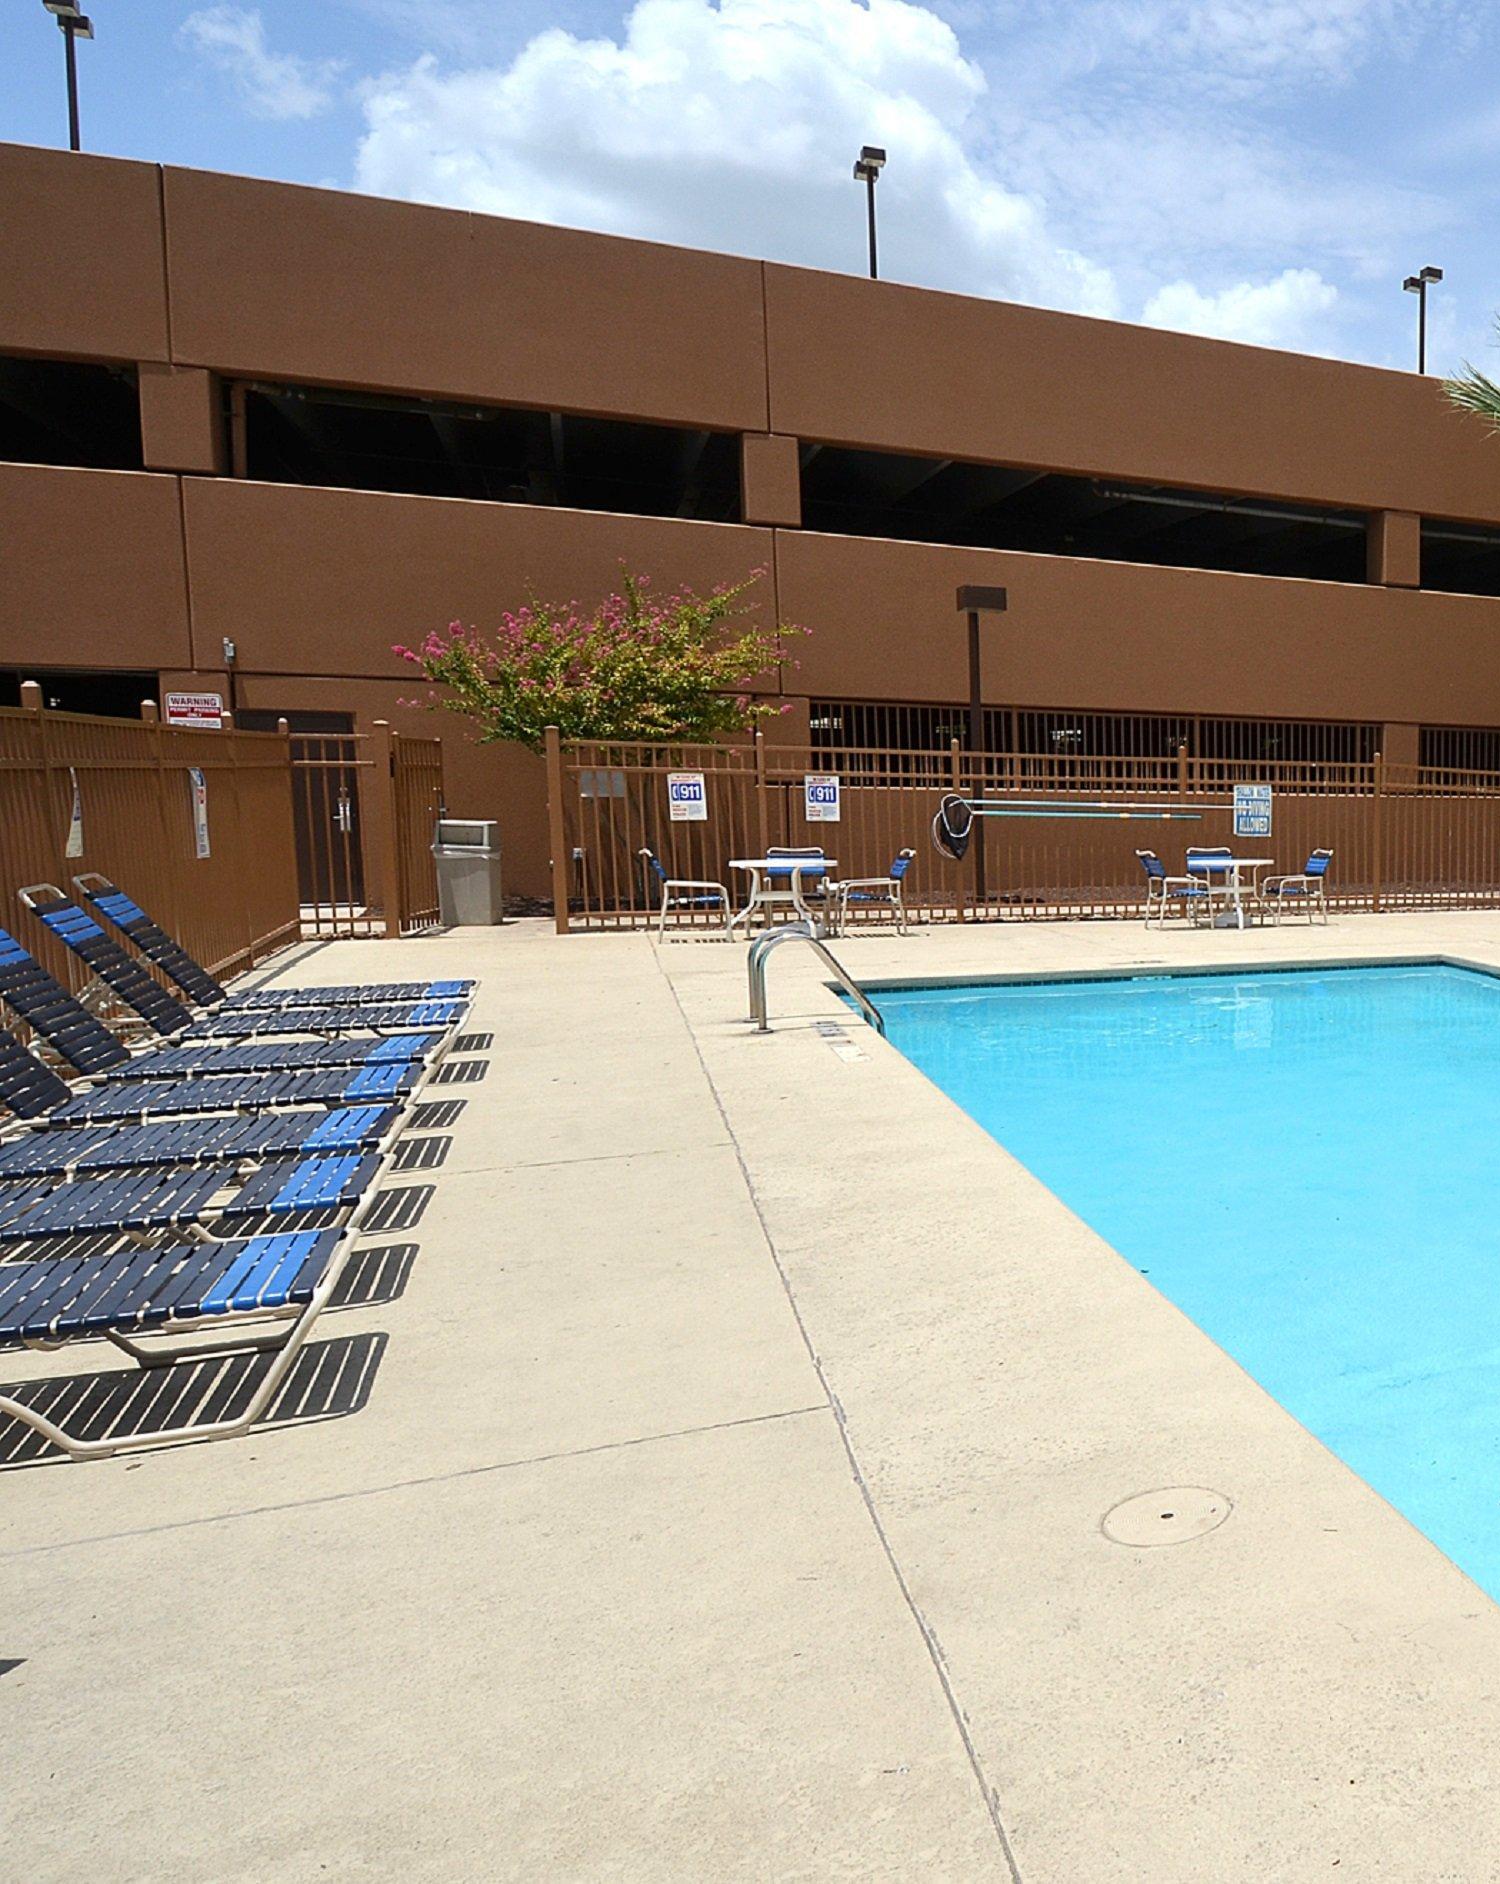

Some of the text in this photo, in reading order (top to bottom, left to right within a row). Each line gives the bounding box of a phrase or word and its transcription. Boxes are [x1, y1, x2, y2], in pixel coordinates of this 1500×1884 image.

[170, 697, 217, 707] WARNING
[680, 785, 701, 799] 911
[816, 787, 835, 801] 911
